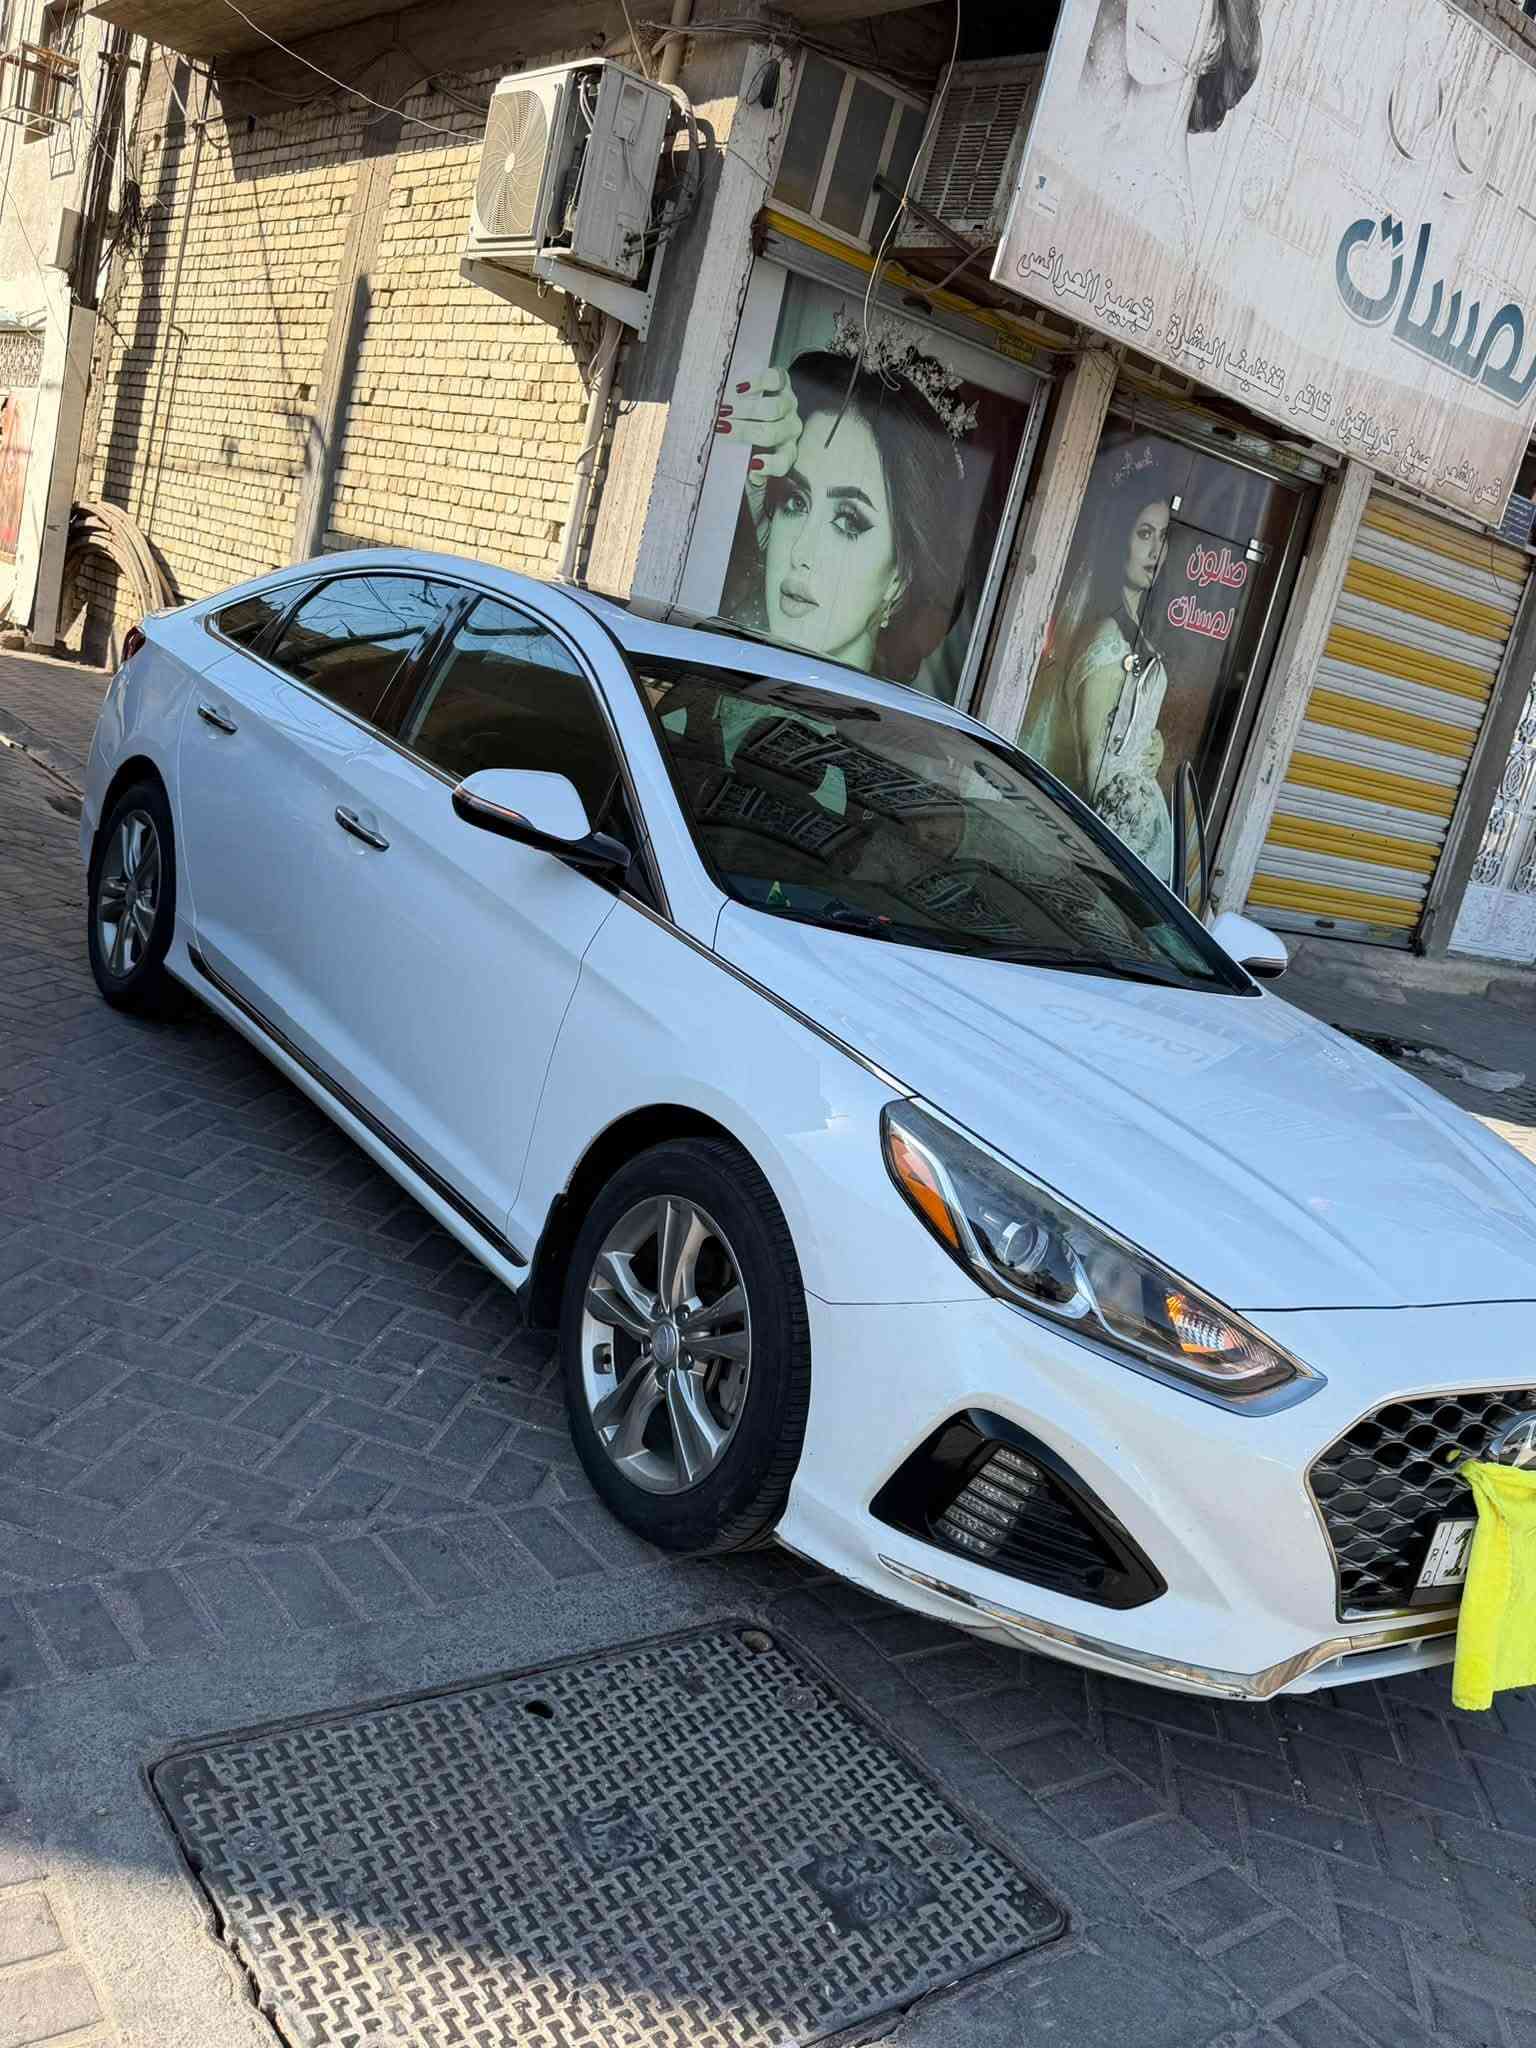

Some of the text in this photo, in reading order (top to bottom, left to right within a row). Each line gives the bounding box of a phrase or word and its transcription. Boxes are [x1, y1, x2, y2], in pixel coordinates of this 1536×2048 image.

[1016, 246, 1100, 303] العرائس
[1094, 278, 1154, 334] تجهيز
[1336, 214, 1536, 405] مسات
[1166, 313, 1226, 370] البشرة
[1224, 349, 1286, 399] تنظيف
[1288, 384, 1332, 422] تاتو
[1472, 477, 1503, 505] قص
[1186, 543, 1248, 588] صالون
[1167, 595, 1235, 640] لمسات
